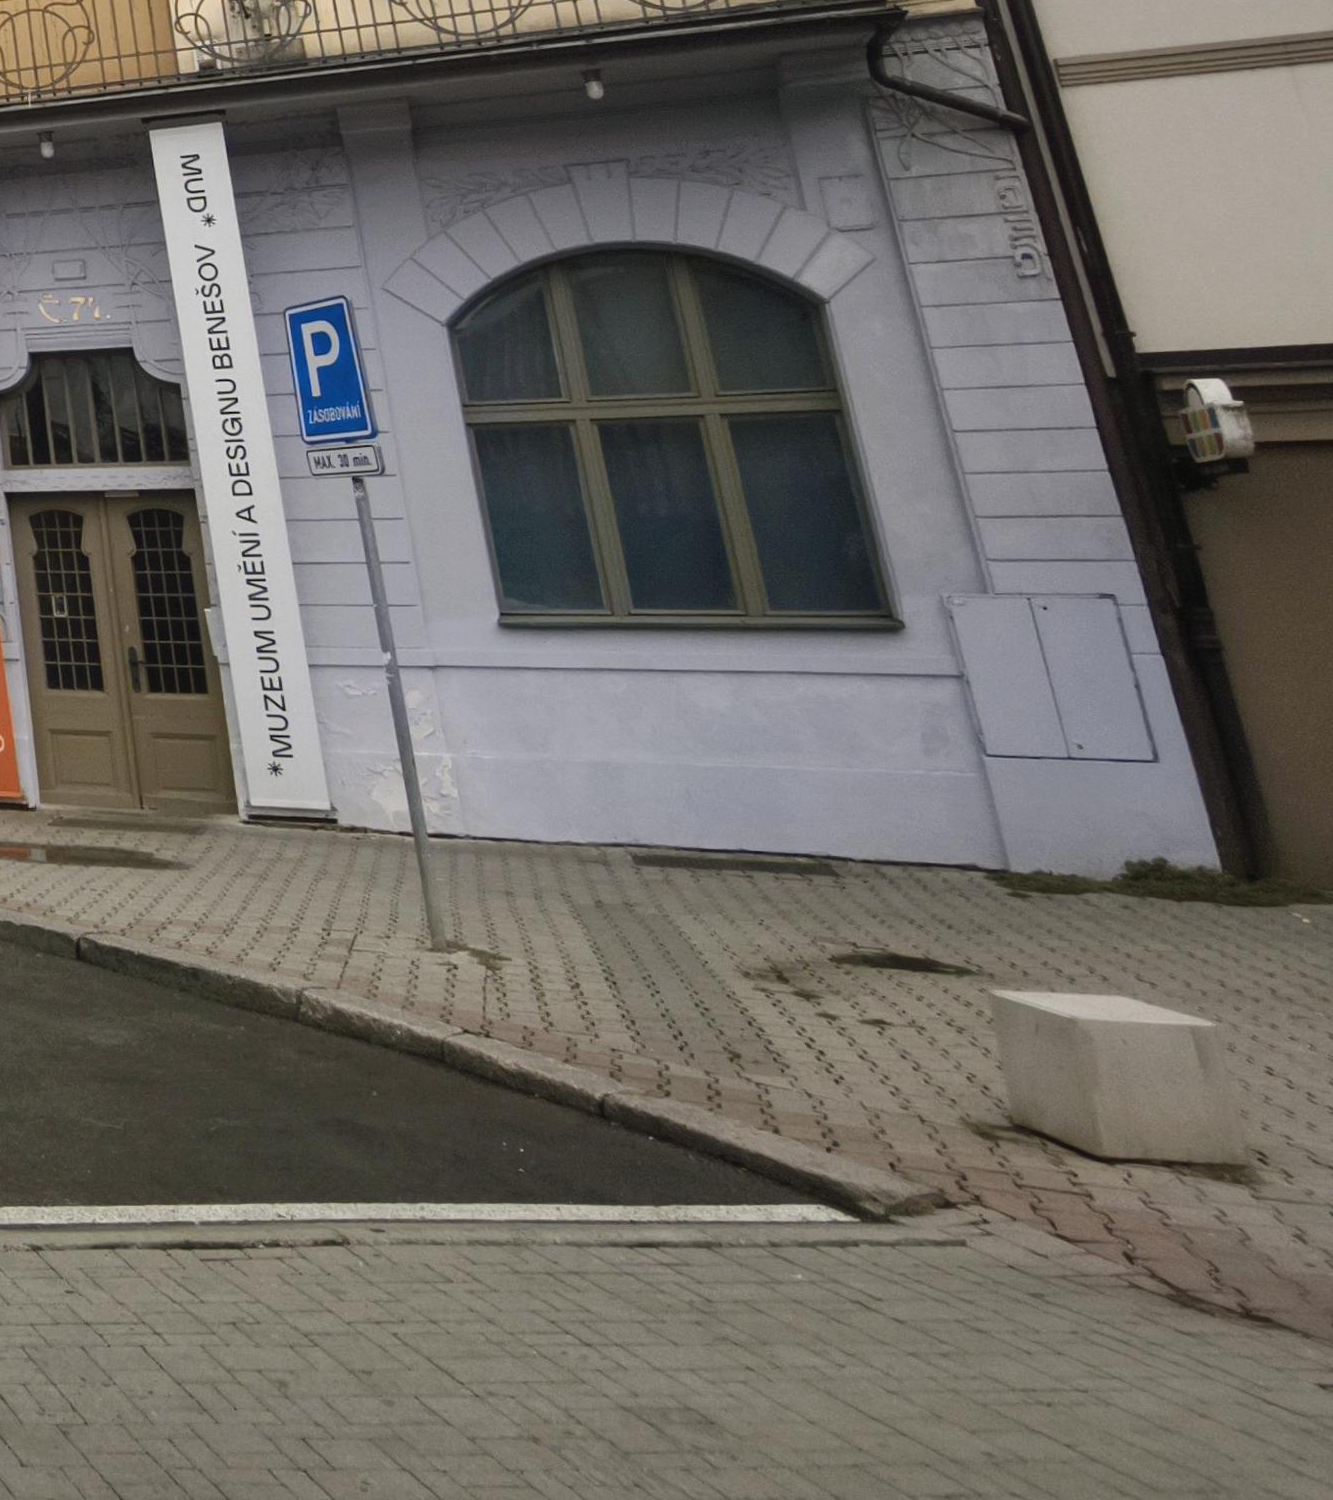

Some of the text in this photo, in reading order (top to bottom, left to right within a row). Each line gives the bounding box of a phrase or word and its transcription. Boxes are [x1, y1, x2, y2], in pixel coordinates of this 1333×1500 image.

[193, 244, 233, 372] BENEŠOV
[300, 319, 341, 398] P
[215, 378, 253, 497] DESIGNU
[307, 401, 362, 425] ZÁSOBOVÁNÍ
[313, 452, 373, 470] MAX. 30 min.
[234, 504, 258, 525] A
[231, 531, 273, 623] UMĚNÍ
